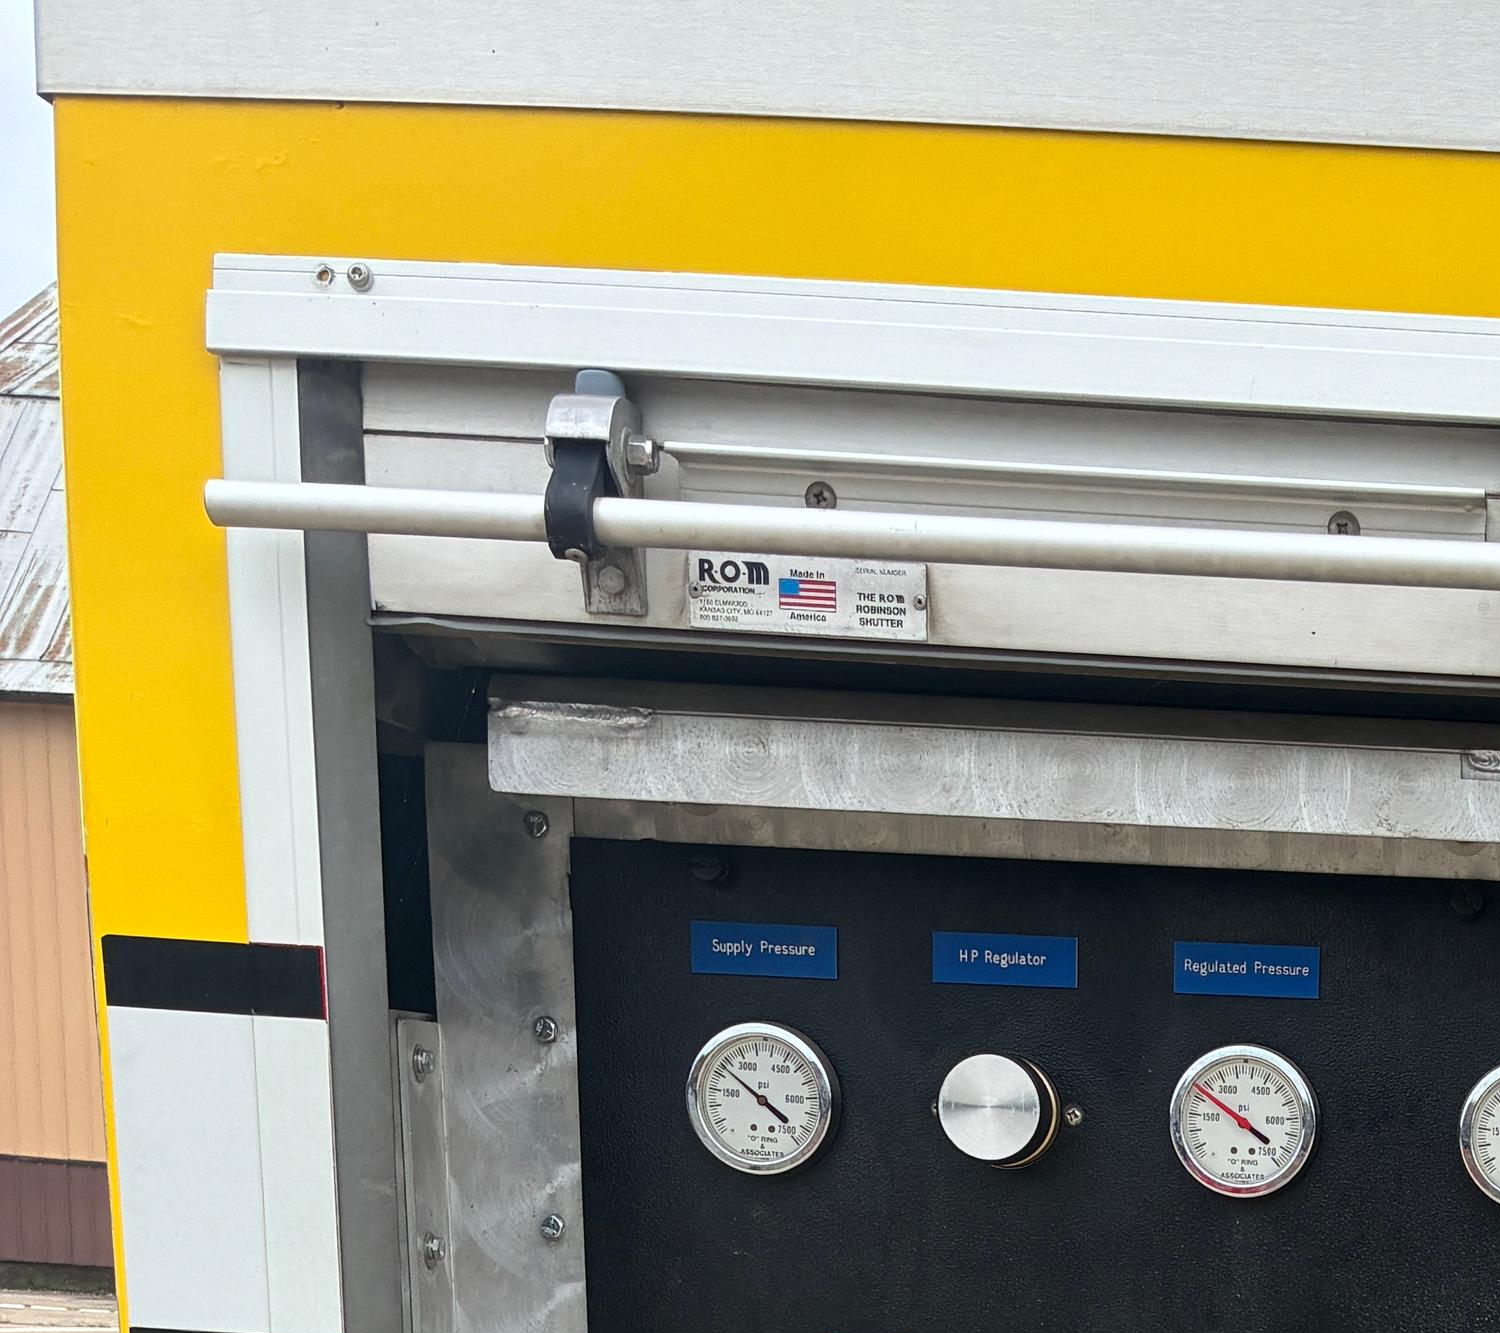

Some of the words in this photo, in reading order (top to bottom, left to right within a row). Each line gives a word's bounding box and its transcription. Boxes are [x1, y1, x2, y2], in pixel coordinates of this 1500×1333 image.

[790, 569, 813, 579] Made
[702, 585, 755, 595] CORPORATION
[857, 592, 876, 602] THE
[856, 604, 907, 617] ROBINSON
[790, 612, 826, 622] America
[859, 617, 903, 628] SHUTTER
[711, 938, 753, 957] Supply
[760, 940, 816, 956] Pressure
[984, 950, 1046, 968] Regulator
[1183, 958, 1247, 976] Regulated
[1254, 961, 1309, 976] Pressure
[738, 1061, 757, 1071] 3000
[771, 1064, 790, 1074] 4500
[758, 1081, 769, 1090] psi
[1218, 1085, 1237, 1095] 3000
[1251, 1086, 1270, 1095] 4500
[722, 1089, 740, 1098] 1500
[785, 1095, 804, 1104] 6000
[1238, 1104, 1249, 1112] psi
[1202, 1112, 1220, 1122] 1500
[1265, 1116, 1284, 1125] 6000
[778, 1125, 797, 1134] 7500
[740, 1148, 785, 1158] ASSOCIATES
[1258, 1147, 1277, 1156] 7500
[1220, 1172, 1265, 1180] ASSOCIATES
